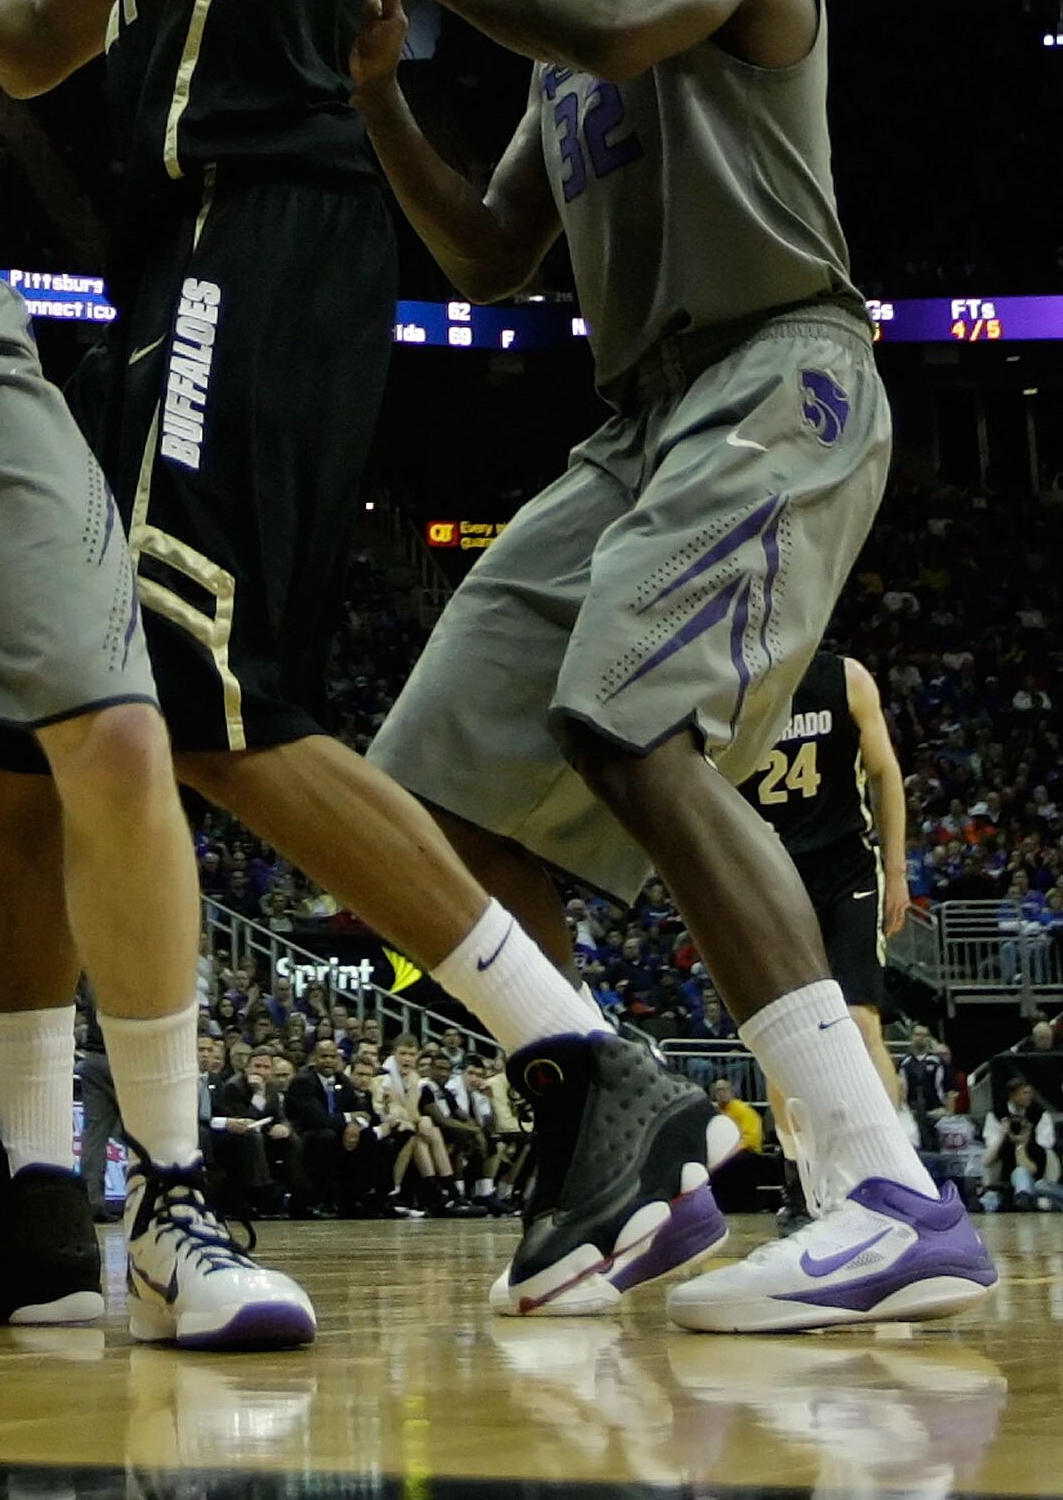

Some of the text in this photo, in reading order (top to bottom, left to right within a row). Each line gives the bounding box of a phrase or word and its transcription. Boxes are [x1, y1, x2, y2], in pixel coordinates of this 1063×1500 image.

[554, 81, 644, 203] 32
[448, 302, 471, 321] 62
[951, 299, 995, 320] FTs
[448, 326, 472, 346] 69
[951, 319, 1002, 342] 4/5
[160, 277, 222, 470] BUFFALOES
[757, 740, 822, 805] 24
[275, 956, 375, 998] Sprint
